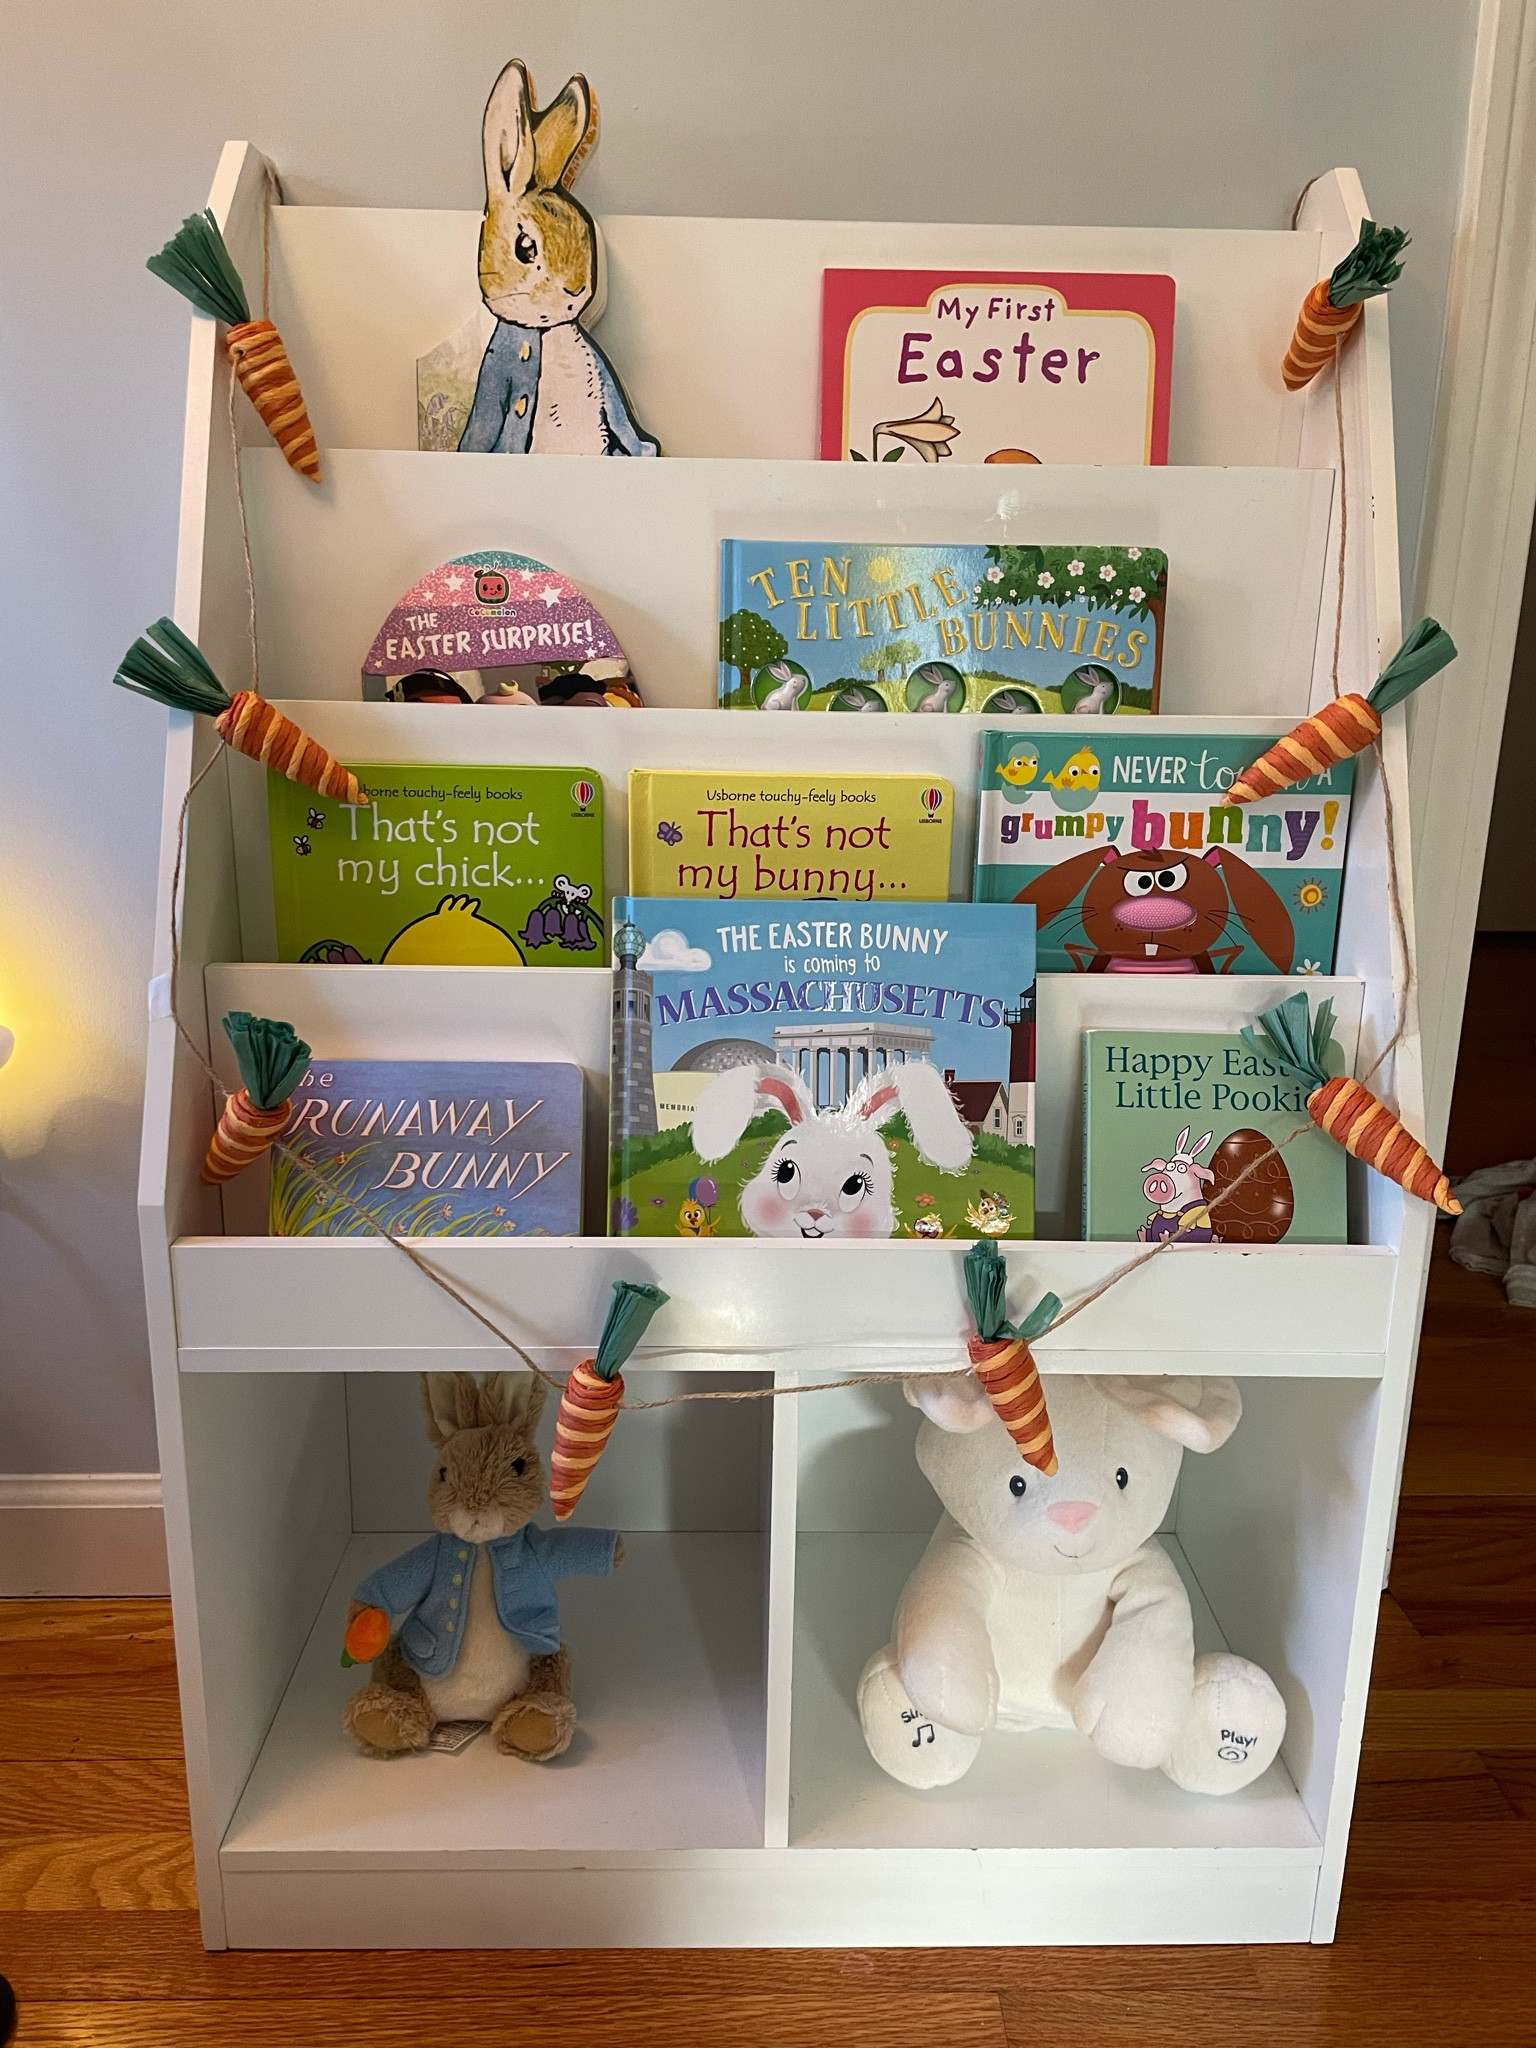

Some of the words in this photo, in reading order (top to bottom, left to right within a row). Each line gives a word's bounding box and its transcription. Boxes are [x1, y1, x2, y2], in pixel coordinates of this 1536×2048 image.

[938, 297, 979, 328] My
[988, 297, 1055, 321] First
[898, 332, 1100, 384] Easter
[748, 556, 852, 609] TEN
[796, 566, 968, 640] LITTLE
[386, 630, 472, 660] EASTER
[482, 619, 594, 655] SURPRISE!
[405, 612, 438, 632] THE
[936, 610, 1148, 669] BUNNIES
[1112, 755, 1187, 784] NEVER
[360, 785, 399, 797] borne
[403, 784, 482, 803] touchy-feely
[486, 786, 523, 800] books
[706, 788, 756, 802] Usborne
[759, 788, 836, 806] touchy-feely
[840, 790, 876, 803] books
[338, 801, 458, 844] That's
[473, 811, 540, 846] not
[697, 808, 811, 849] That's
[826, 816, 892, 850] not
[1000, 812, 1124, 844] grumpy
[1131, 799, 1340, 861] bunny!
[338, 857, 400, 896] my
[415, 846, 544, 888] chick...
[678, 863, 738, 900] my
[755, 854, 907, 902] bunny...
[716, 924, 763, 954] THE
[768, 921, 852, 950] EASTER
[859, 922, 949, 955] BUNNY
[784, 956, 796, 974] is
[804, 957, 856, 976] coming
[864, 955, 881, 972] to
[655, 979, 1008, 1030] MASSACHUSETTS
[299, 1069, 334, 1087] he
[1105, 1046, 1214, 1081] Happy
[659, 1103, 697, 1112] MEMORIA
[1115, 1081, 1202, 1110] Little
[283, 1098, 545, 1145] RUNAWAY
[371, 1152, 573, 1201] BUNNY
[1220, 1729, 1258, 1748] Play!
